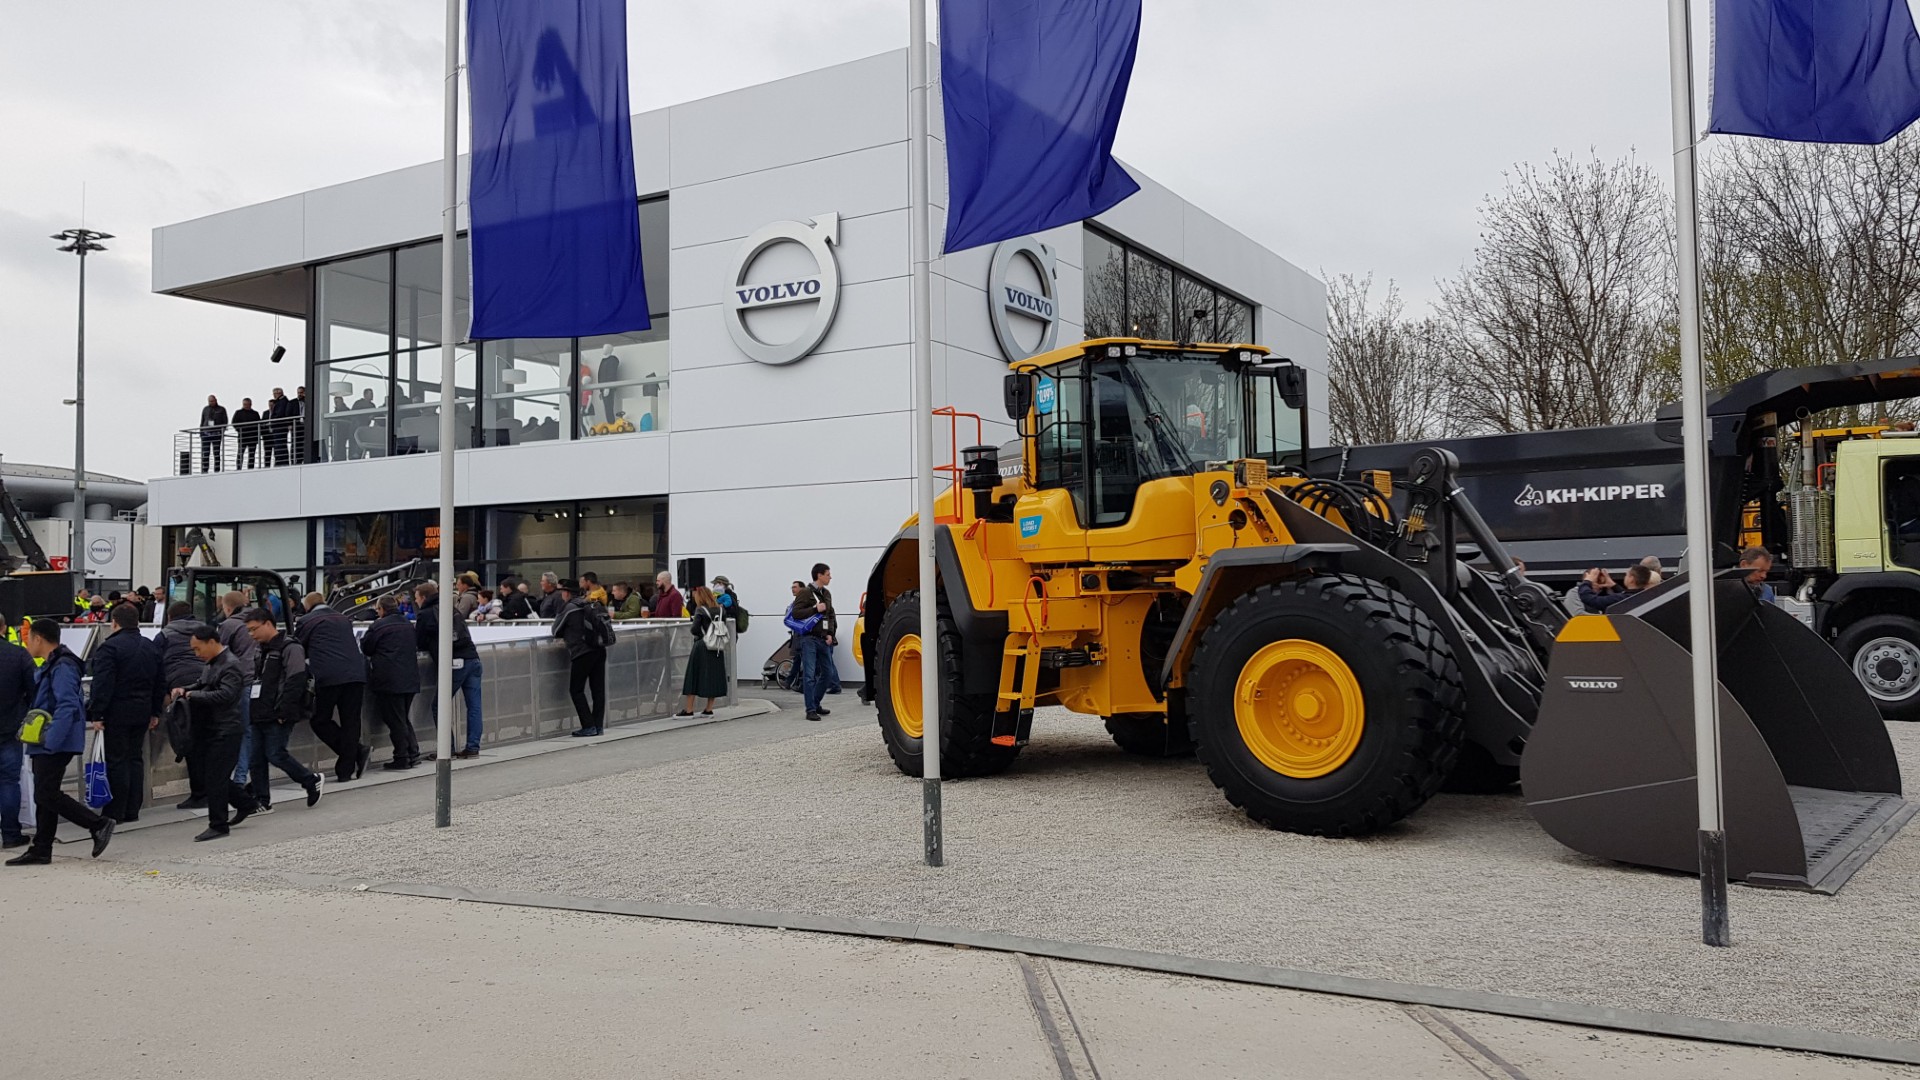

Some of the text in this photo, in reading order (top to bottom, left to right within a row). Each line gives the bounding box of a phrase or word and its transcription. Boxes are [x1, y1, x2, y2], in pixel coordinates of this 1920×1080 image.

[736, 279, 821, 304] VOLVO
[1004, 286, 1053, 317] VOLVO
[1546, 483, 1666, 504] KH-KIPPER
[13, 515, 27, 539] VOLVO
[1853, 551, 1877, 559] 540
[1568, 681, 1618, 689] VOLVO
